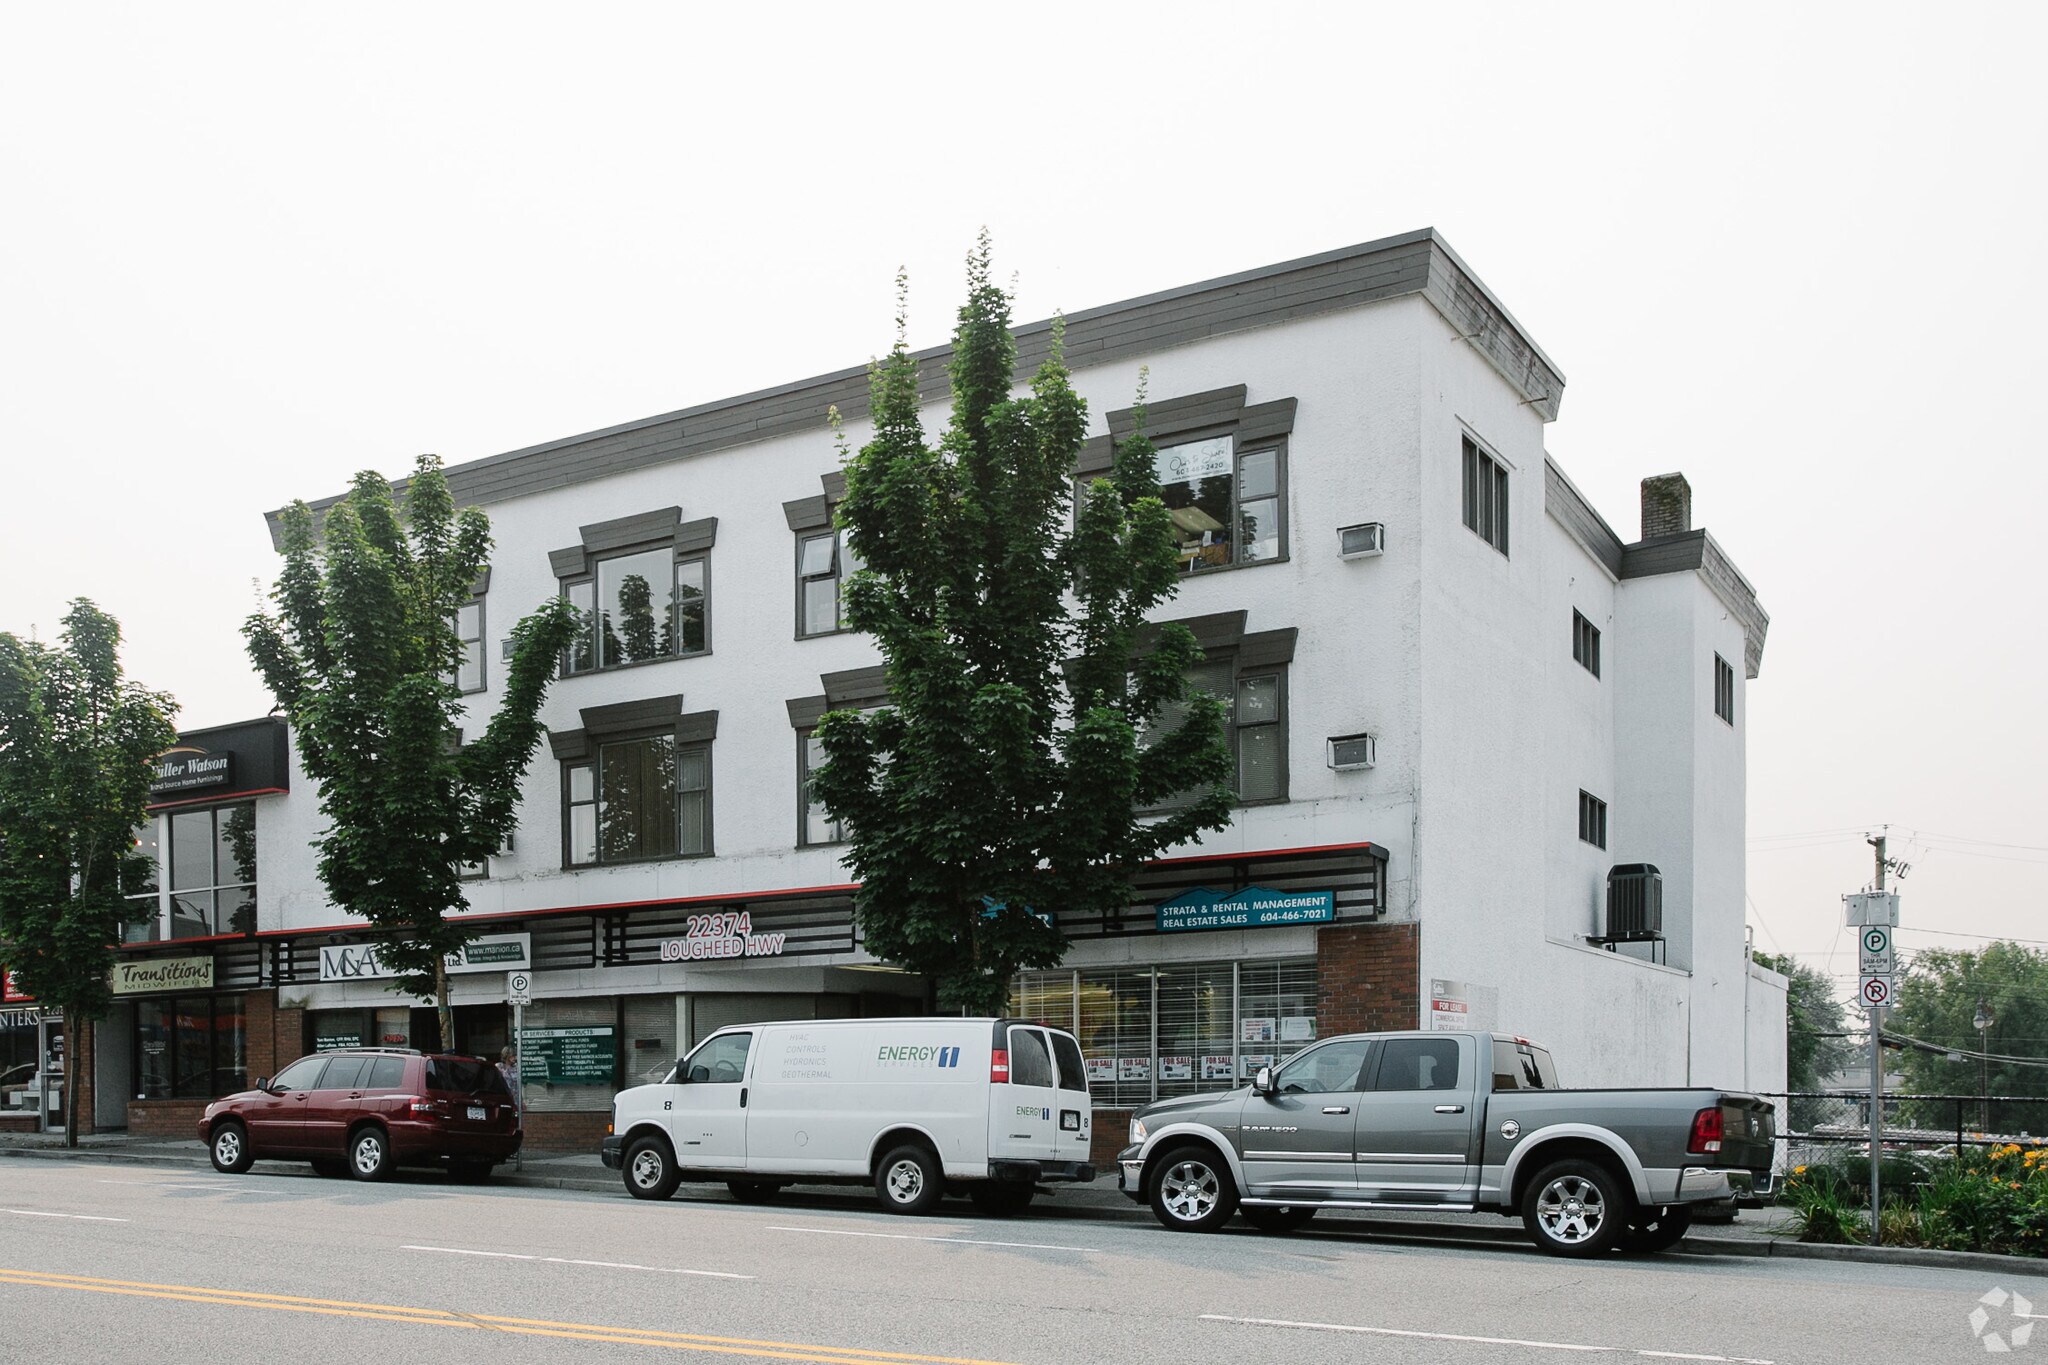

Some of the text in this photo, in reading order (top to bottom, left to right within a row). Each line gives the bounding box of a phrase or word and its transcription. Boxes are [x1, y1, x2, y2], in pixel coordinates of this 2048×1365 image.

[187, 758, 228, 774] Watson
[1163, 896, 1327, 916] STRATA & RENTAL MANAGEMENT
[1163, 909, 1327, 928] REAL ESTATE SALES 604-466-7021
[687, 913, 751, 938] 22374
[468, 944, 521, 956] www.manion.ca
[662, 934, 784, 959] LOUGHEED HWY
[322, 946, 380, 979] M&A
[121, 962, 212, 982] Transitions
[124, 979, 210, 990] MIDWIFERY
[1439, 1001, 1463, 1012] FOR LEASE
[789, 1033, 809, 1041] HVAC
[786, 1045, 827, 1054] CONTROLS
[877, 1046, 940, 1061] ENERGY
[783, 1057, 827, 1066] HYDRONICS
[1099, 1059, 1113, 1067] SALE
[1134, 1058, 1148, 1066] SALE
[1163, 1057, 1190, 1065] FOR SALE
[1217, 1056, 1232, 1064] SALE
[781, 1070, 833, 1079] GEOTHERMAL
[664, 1100, 673, 1111] 8
[1016, 1106, 1042, 1117] ENERGY
[1083, 1117, 1089, 1128] 8
